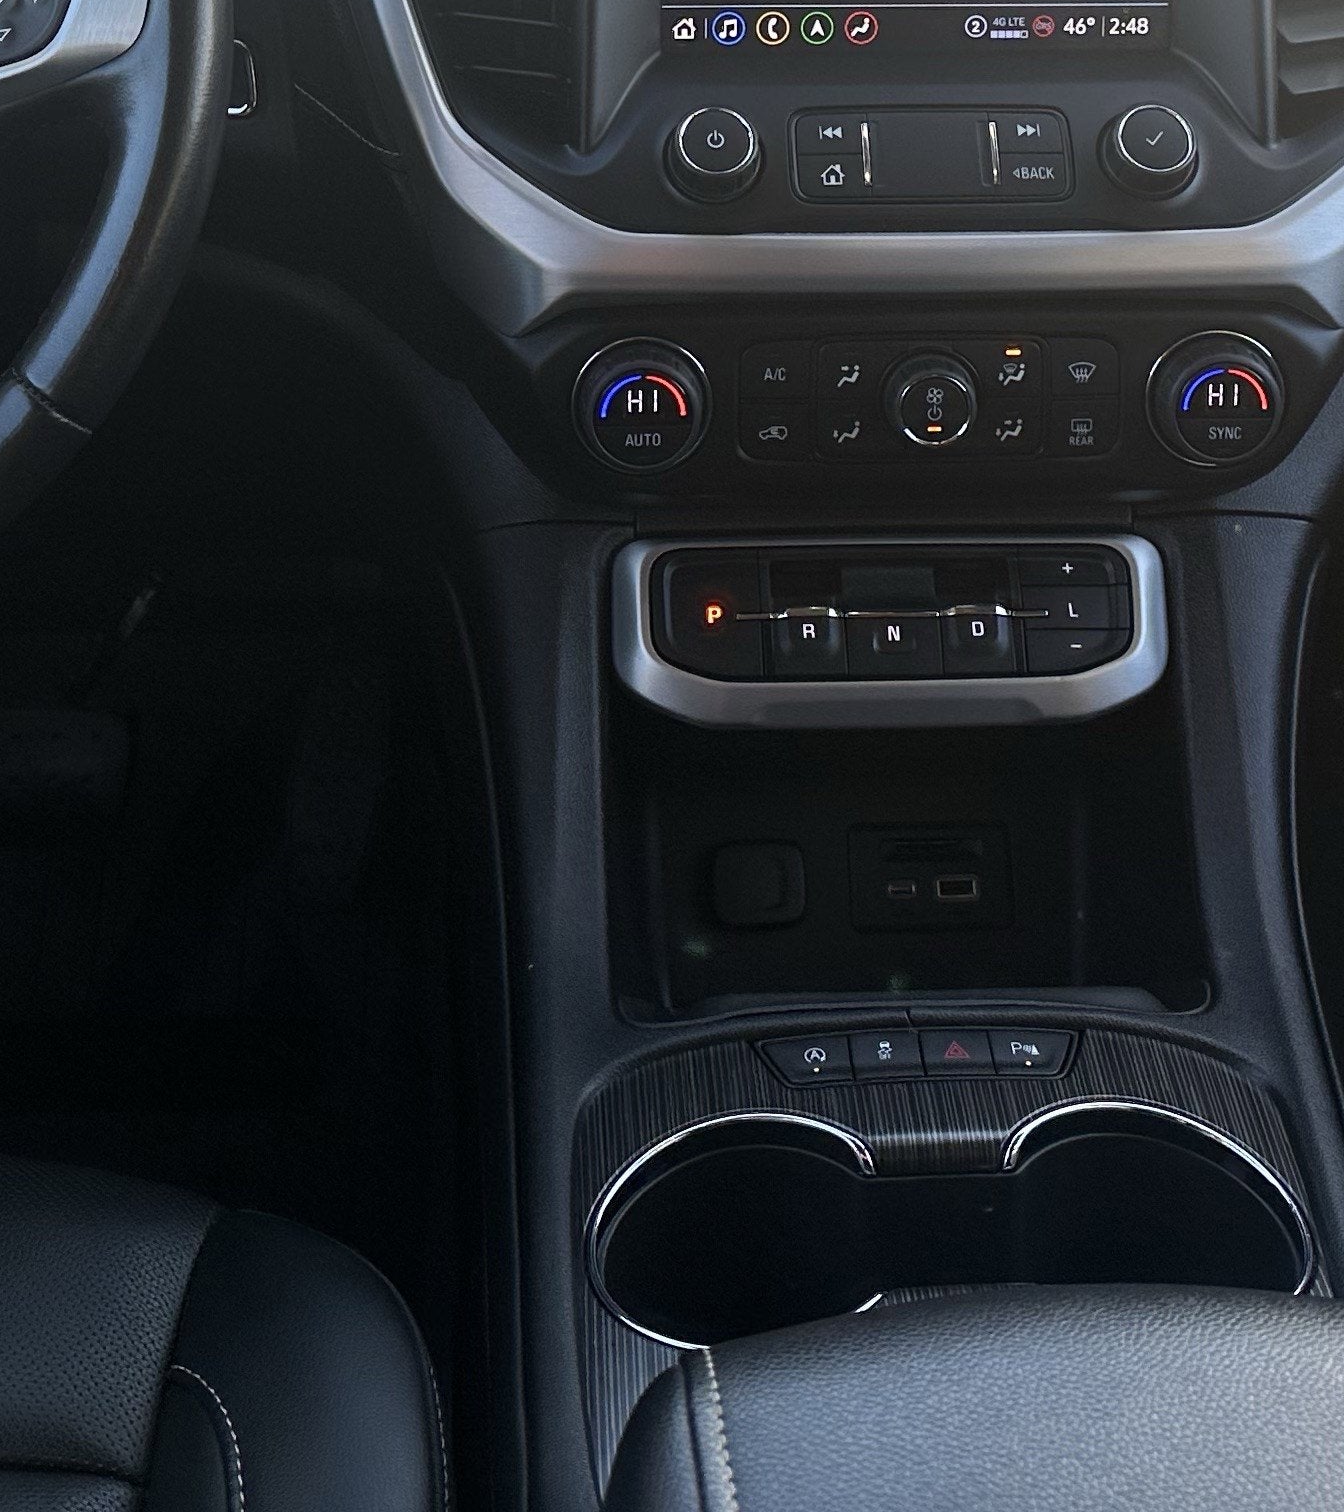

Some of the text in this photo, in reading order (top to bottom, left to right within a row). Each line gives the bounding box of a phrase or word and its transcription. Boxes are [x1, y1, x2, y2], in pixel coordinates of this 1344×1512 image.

[992, 17, 1026, 26] 4G LTE
[1063, 16, 1096, 35] 46°
[1109, 17, 1149, 35] 2:48
[1021, 165, 1054, 180] BACK
[763, 366, 787, 383] A/C
[627, 390, 659, 413] HI
[1207, 385, 1239, 407] HI
[624, 432, 662, 447] AUTO
[1068, 435, 1094, 446] REAR
[1207, 426, 1243, 441] SYNC
[705, 605, 722, 624] P
[1068, 604, 1078, 618] L
[802, 624, 816, 639] R
[887, 626, 901, 641] N
[972, 621, 985, 637] D
